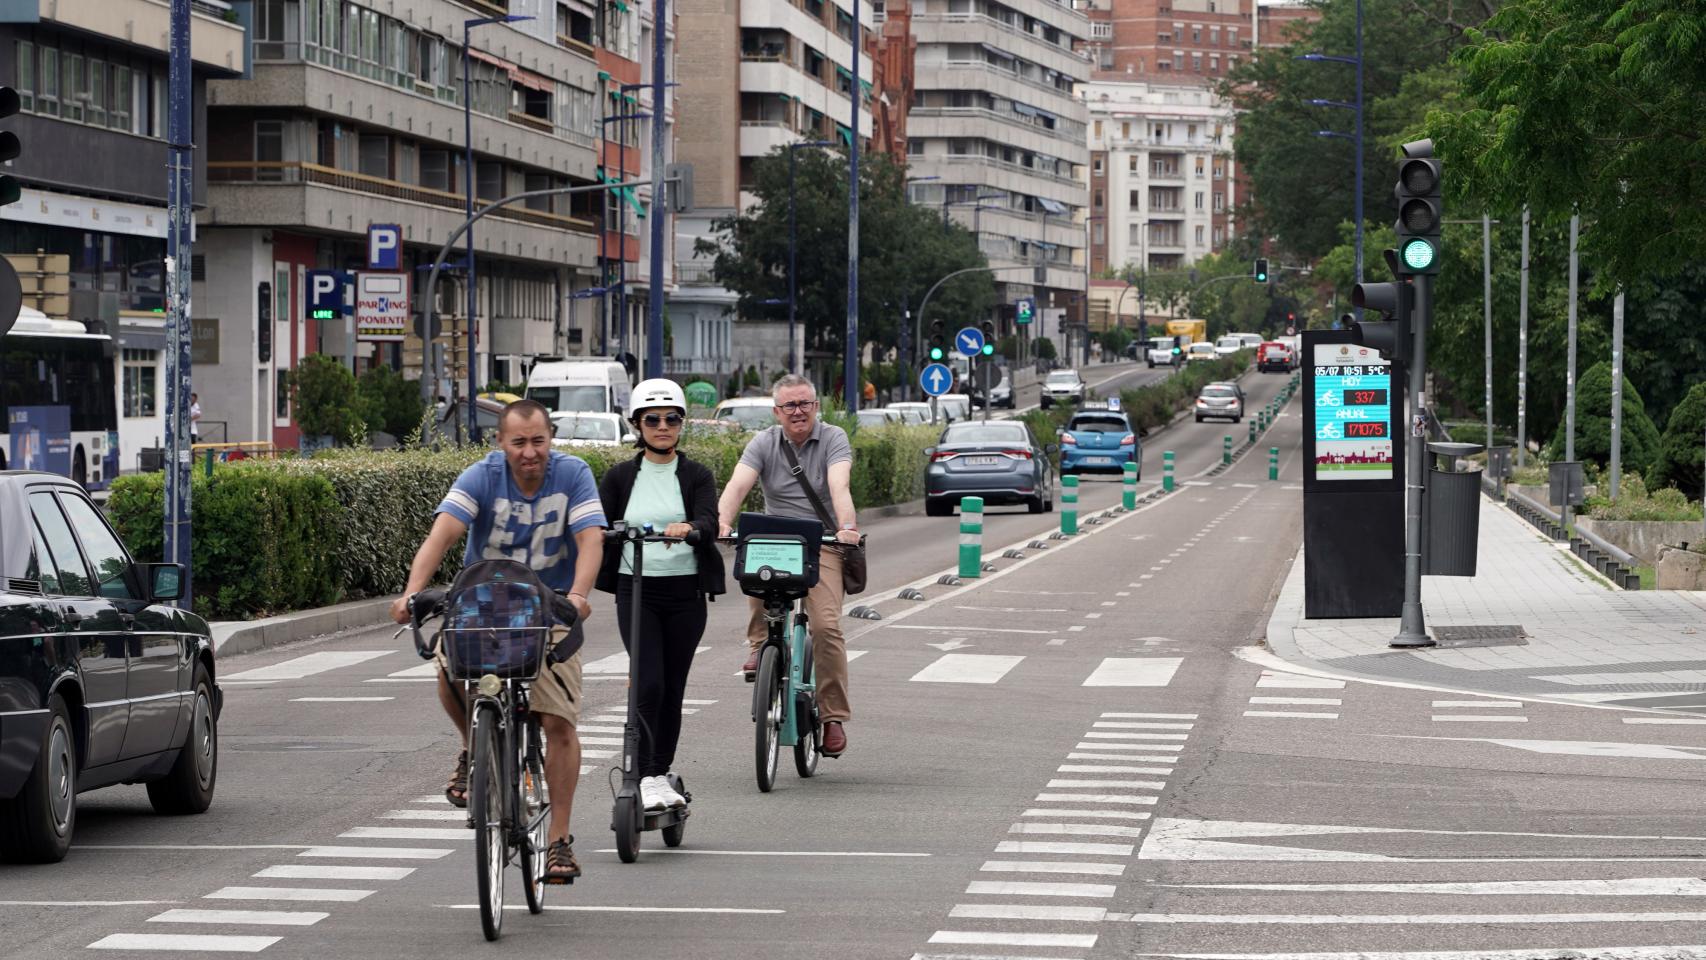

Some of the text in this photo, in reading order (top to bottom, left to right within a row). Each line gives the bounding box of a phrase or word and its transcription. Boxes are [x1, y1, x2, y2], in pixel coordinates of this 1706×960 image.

[371, 229, 397, 263] P
[313, 275, 335, 305] P
[359, 297, 407, 312] PARKING
[313, 310, 333, 319] LIBRE
[1315, 366, 1339, 376] 05/07
[1343, 366, 1363, 376] 10:51
[1342, 376, 1361, 387] HOY
[1355, 391, 1375, 404] 337
[1335, 408, 1369, 419] ANUAL
[1349, 423, 1383, 436] 171075
